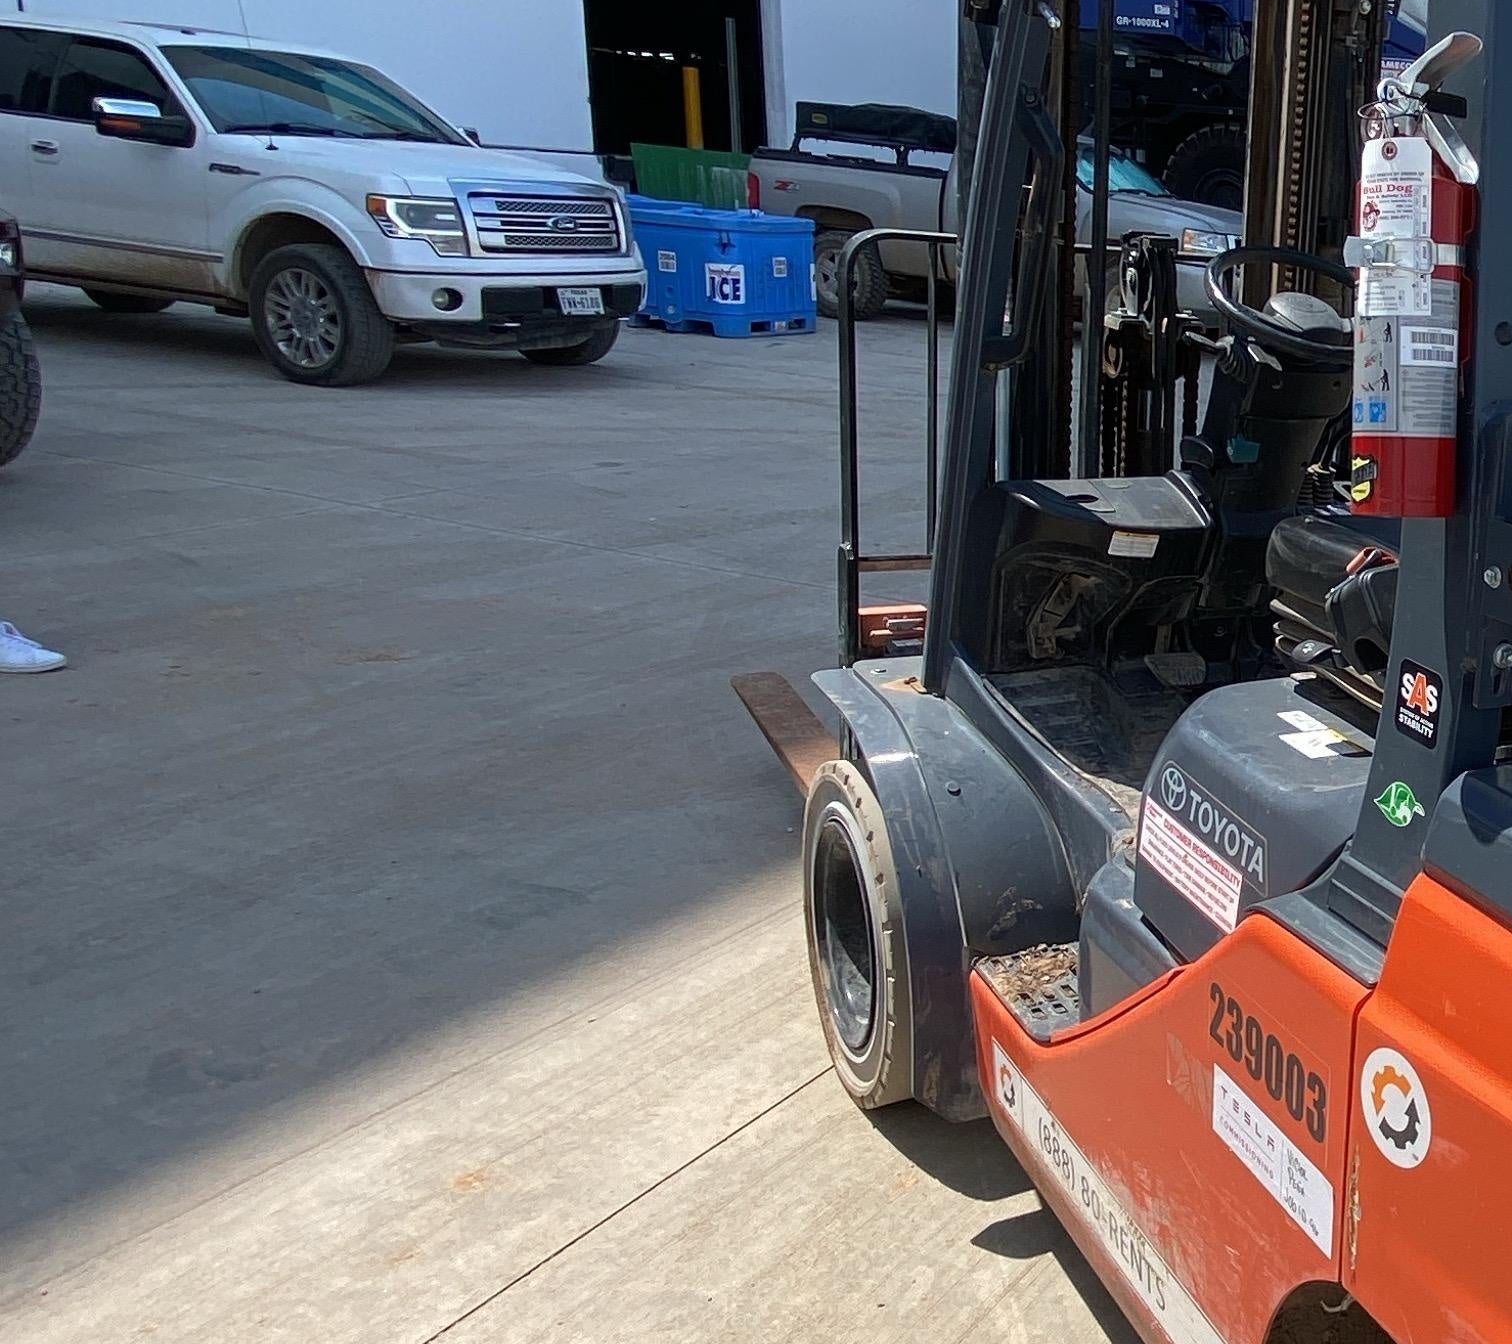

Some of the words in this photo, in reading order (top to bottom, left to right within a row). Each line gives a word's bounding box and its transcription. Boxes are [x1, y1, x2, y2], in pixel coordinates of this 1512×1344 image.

[1386, 183, 1414, 193] Dog
[709, 276, 742, 301] ICE
[1401, 671, 1438, 717] SAS
[1188, 789, 1264, 884] TOYOTA
[1209, 982, 1327, 1144] 239003
[1220, 1085, 1277, 1153] TESLA
[1037, 1116, 1076, 1191] (888)
[1079, 1174, 1167, 1312] 80-RENTS
